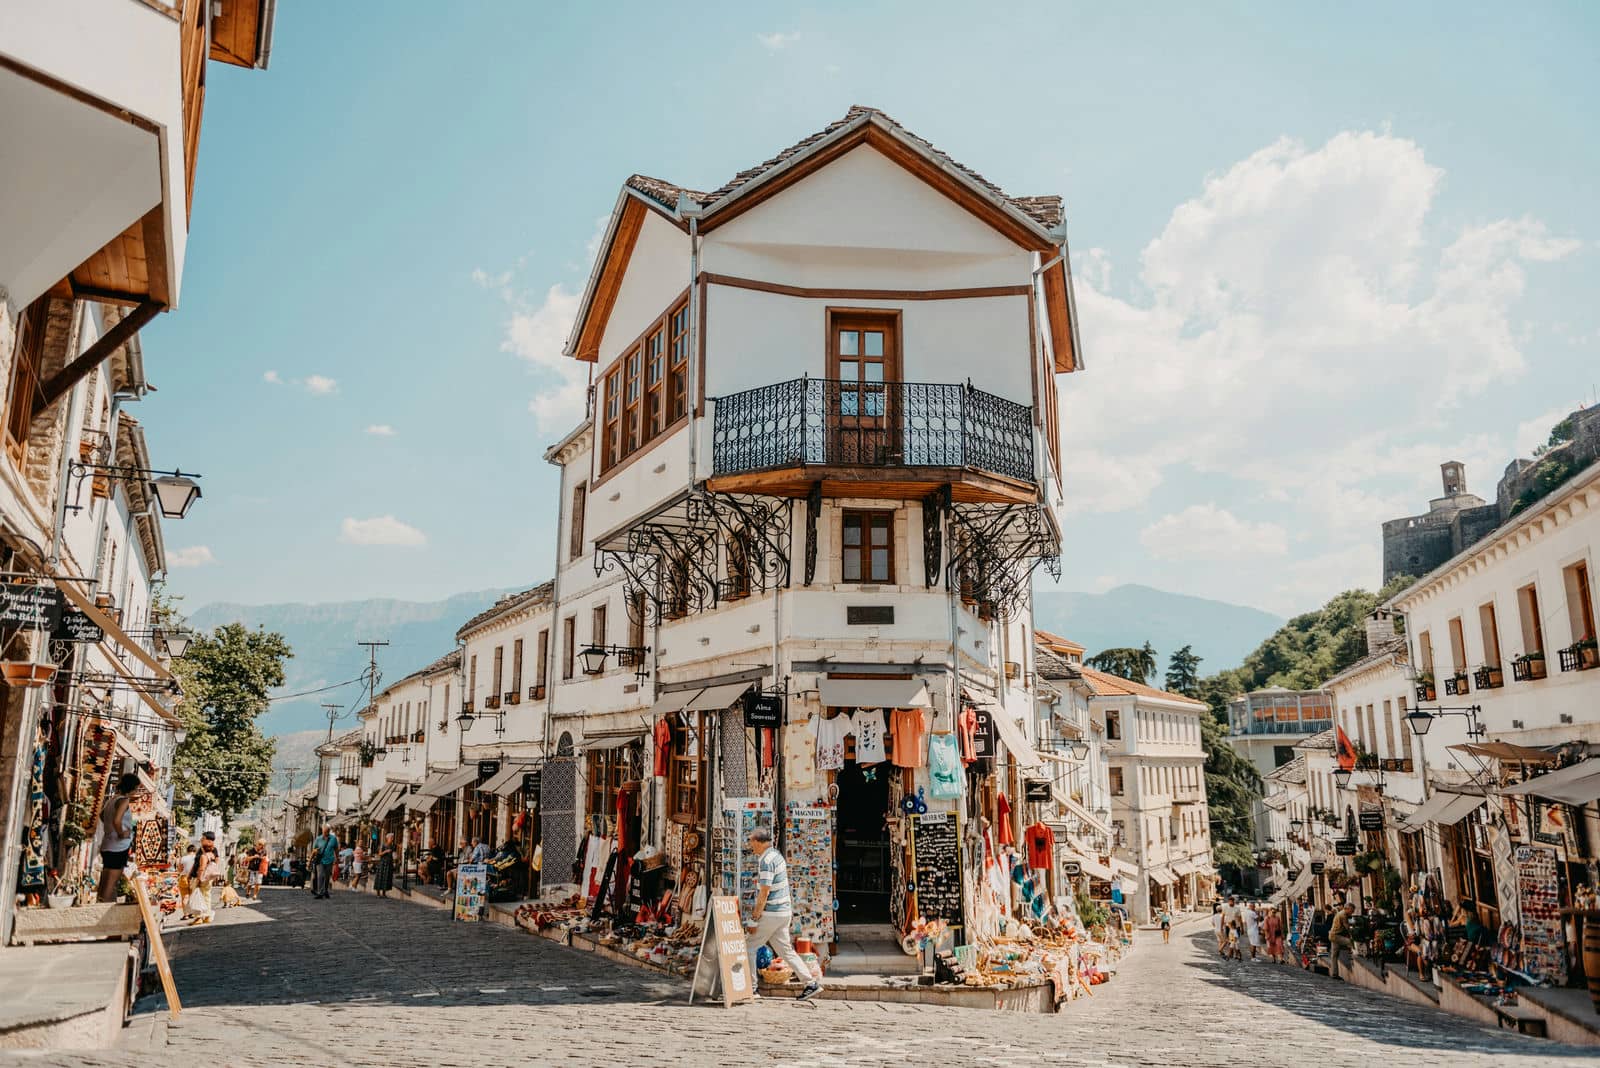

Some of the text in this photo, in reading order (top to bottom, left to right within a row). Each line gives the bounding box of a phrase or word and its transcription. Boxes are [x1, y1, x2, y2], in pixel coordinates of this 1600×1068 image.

[794, 809, 823, 817] MAGNETS
[721, 900, 736, 914] OLD
[721, 919, 741, 935] WELL
[721, 939, 746, 954] INSIDE
